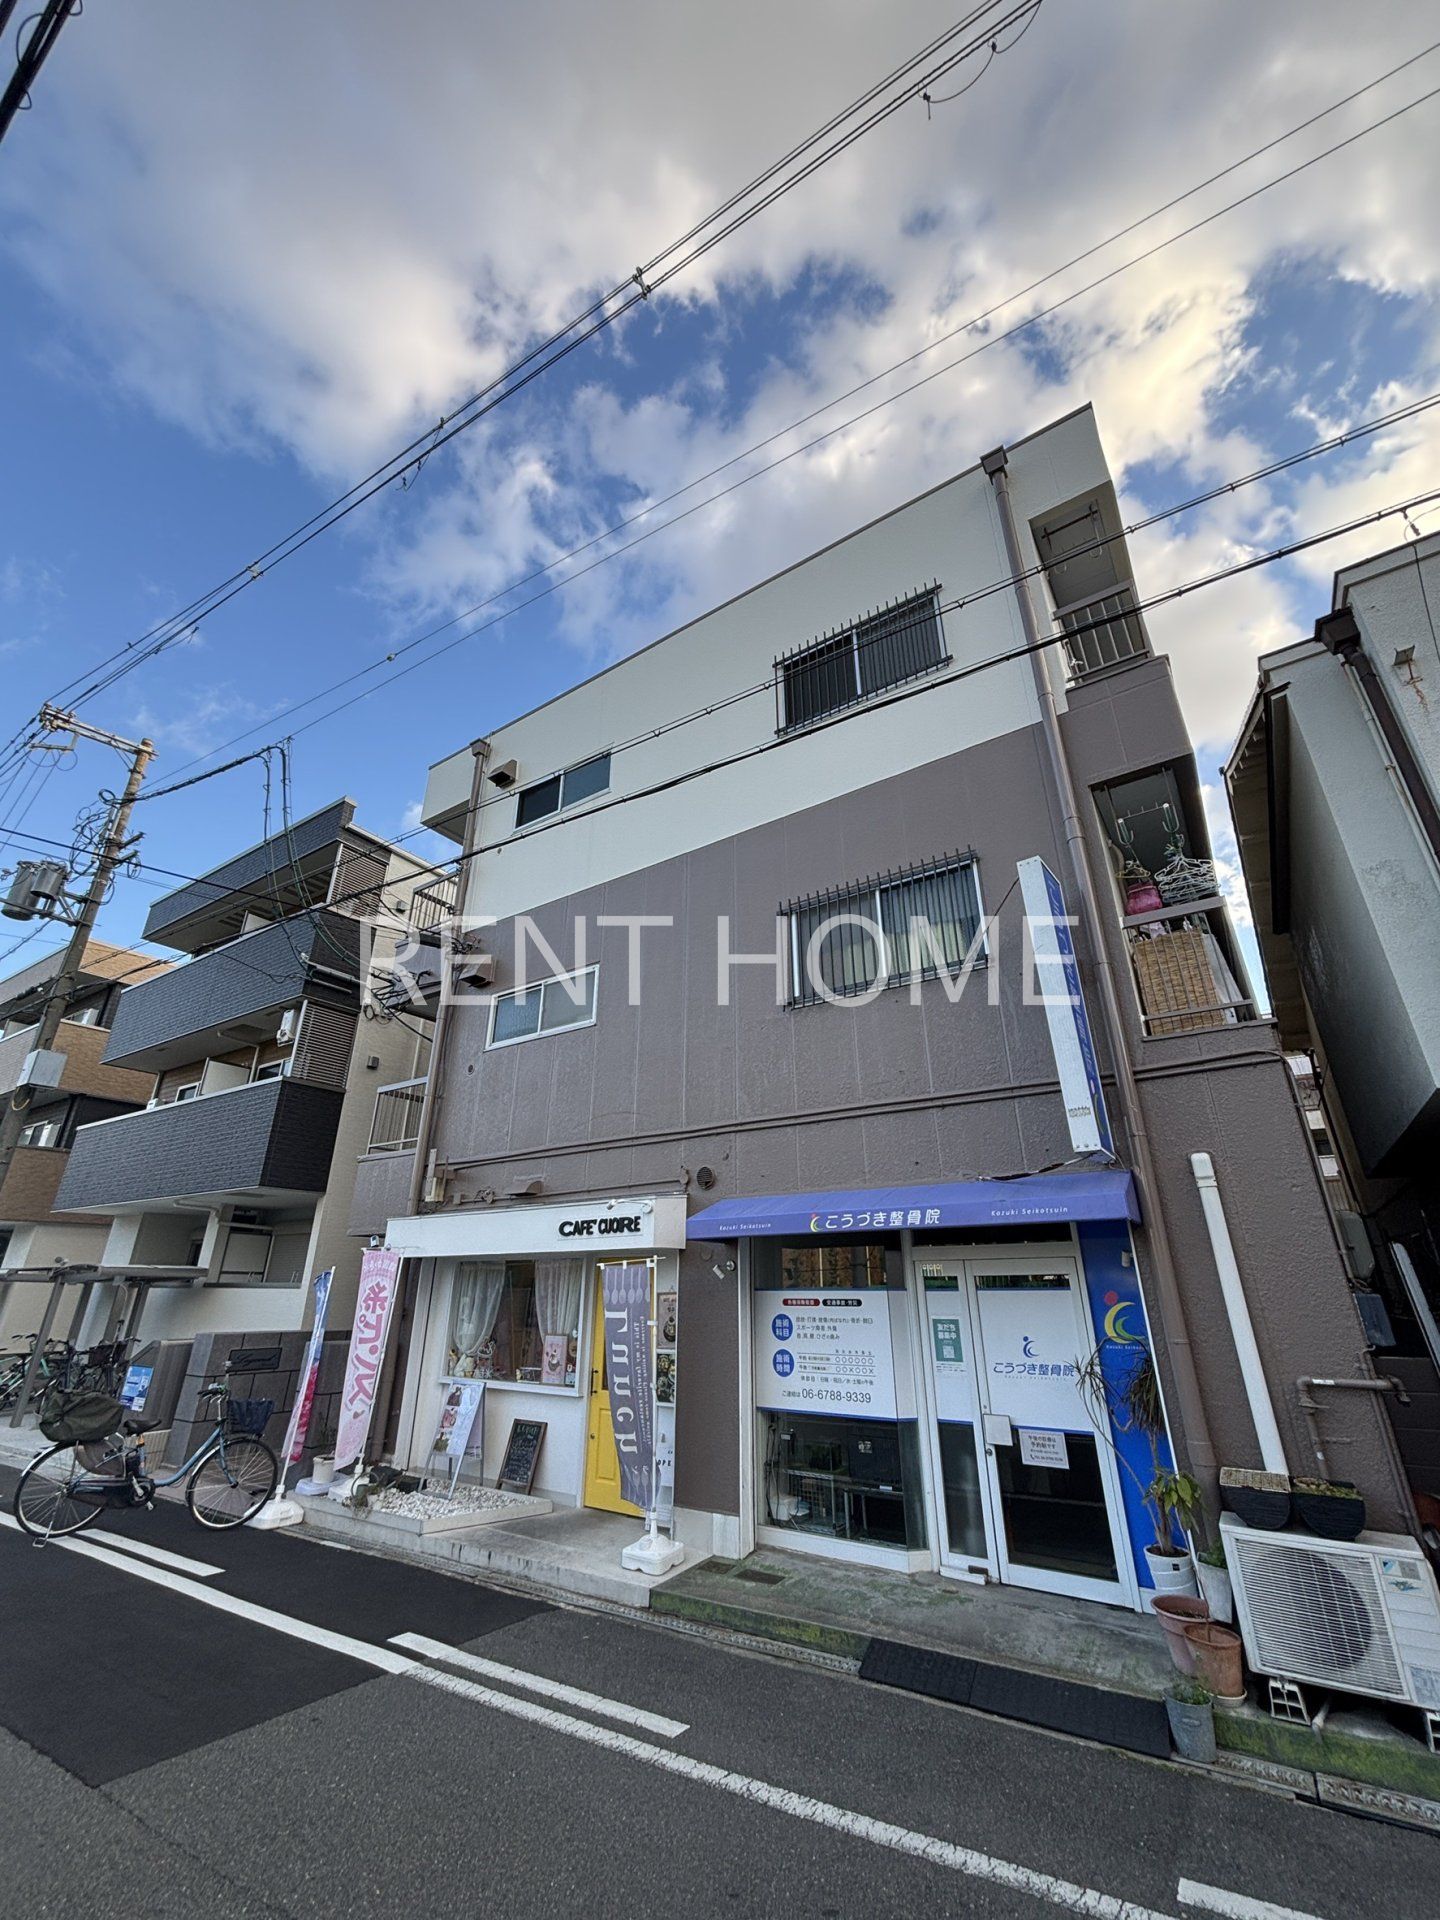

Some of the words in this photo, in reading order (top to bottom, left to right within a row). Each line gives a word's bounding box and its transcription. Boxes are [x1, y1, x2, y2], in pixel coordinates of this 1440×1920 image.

[825, 1208, 941, 1229] こうづき整骨院
[991, 1208, 1019, 1217] Kozuki
[1021, 1206, 1069, 1215] Seikotsuin
[599, 1216, 641, 1234] CUORE
[993, 1362, 1075, 1377] こうづき整骨院
[802, 1388, 871, 1404] 06-6788-9339
